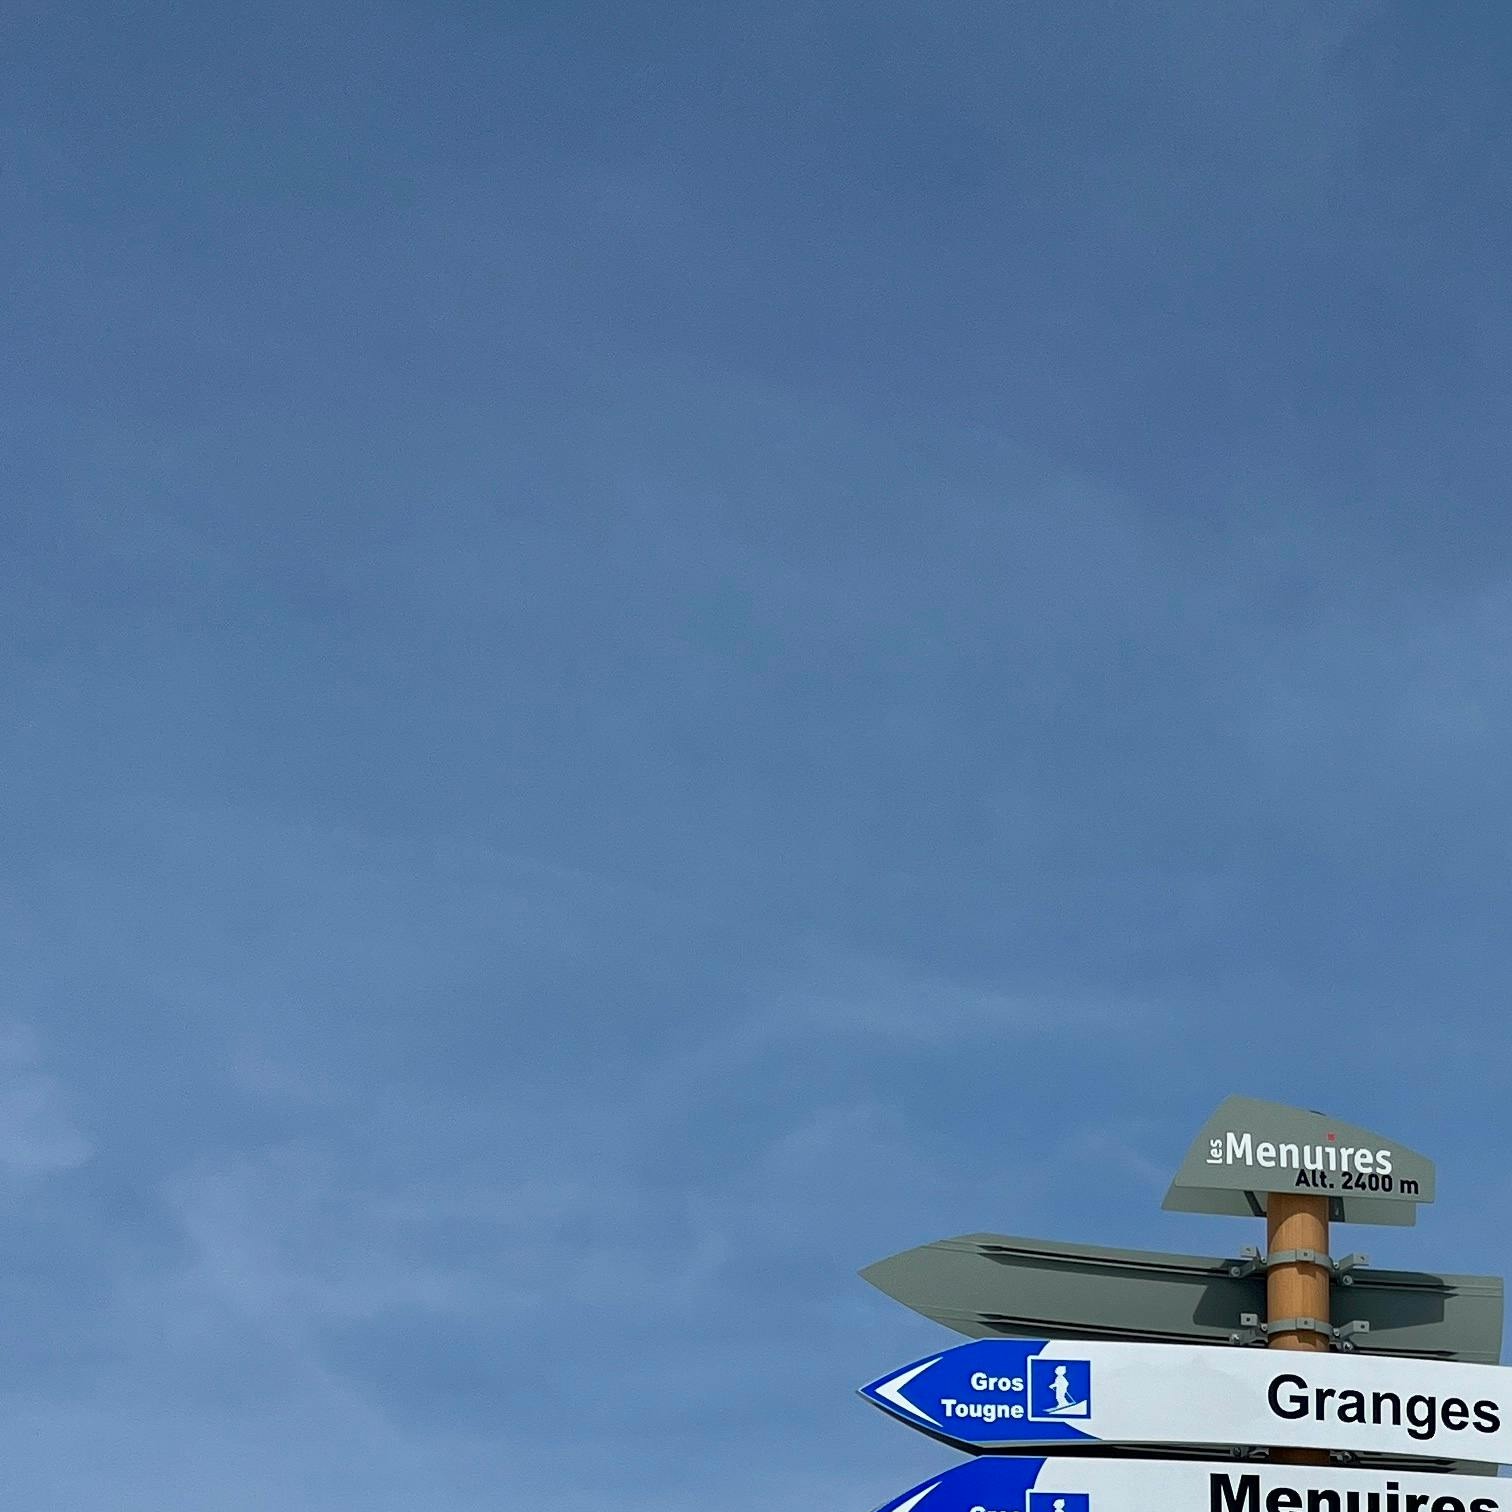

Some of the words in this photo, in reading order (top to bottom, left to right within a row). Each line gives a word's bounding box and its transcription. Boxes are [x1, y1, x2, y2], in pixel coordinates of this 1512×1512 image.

[1206, 1139, 1223, 1164] les
[1226, 1132, 1393, 1175] Menuires
[1295, 1168, 1335, 1189] Alt.
[1341, 1171, 1393, 1192] 2400
[1399, 1178, 1419, 1194] m
[970, 1372, 1024, 1392] Gros
[940, 1398, 1024, 1420] Tougne
[1267, 1373, 1501, 1440] Granges
